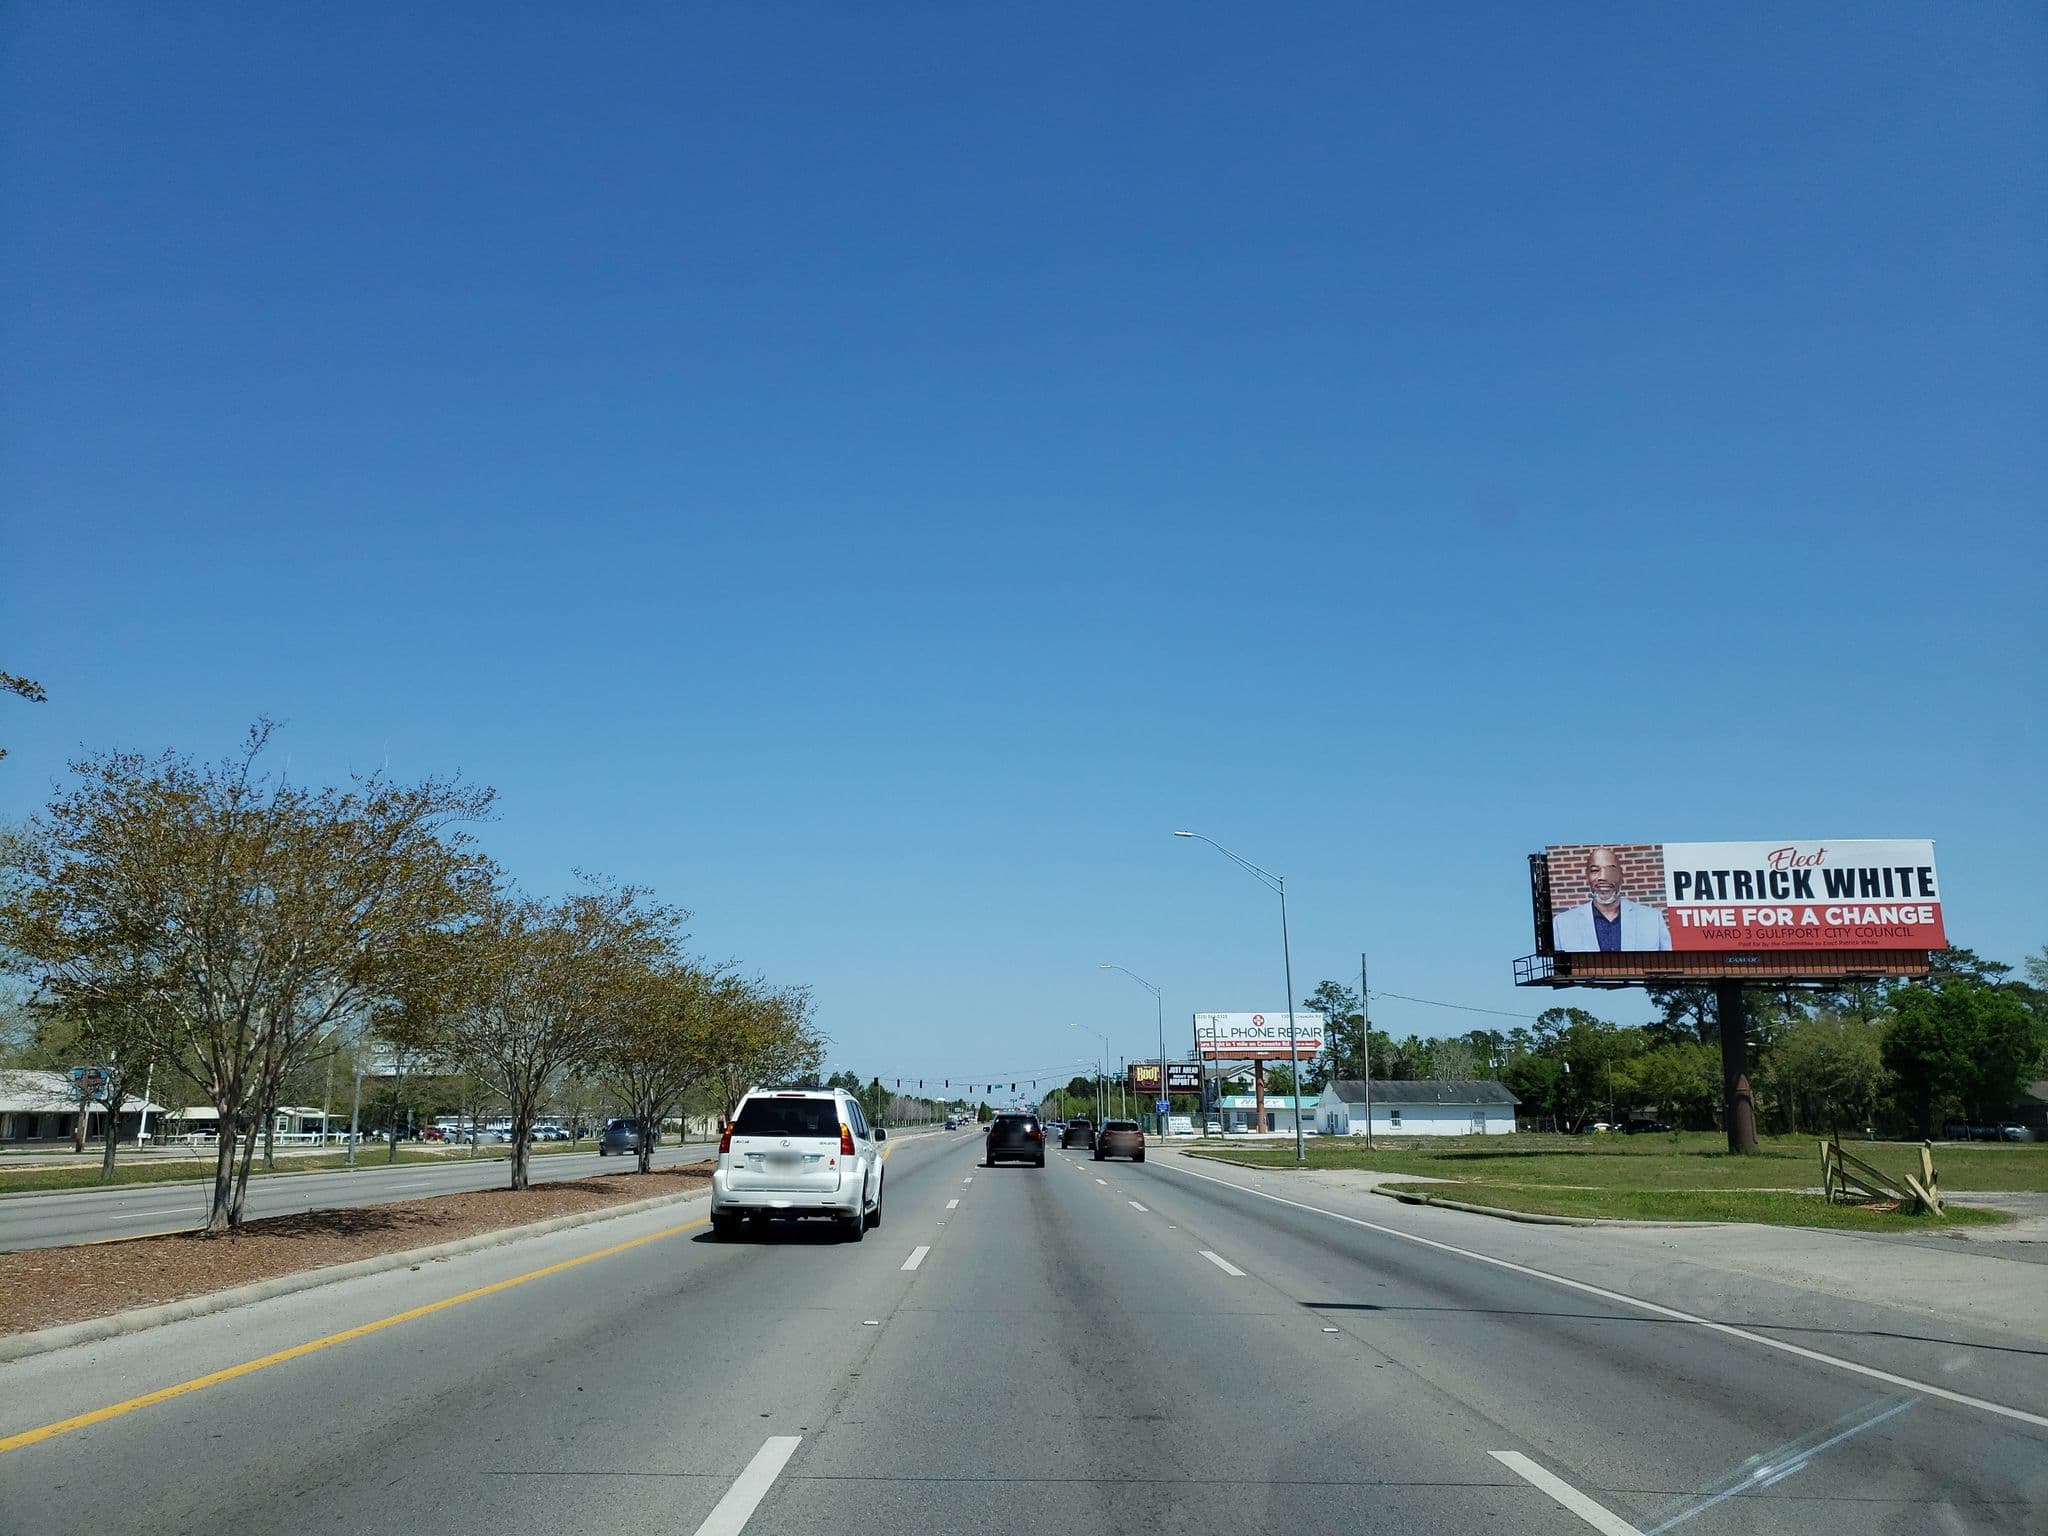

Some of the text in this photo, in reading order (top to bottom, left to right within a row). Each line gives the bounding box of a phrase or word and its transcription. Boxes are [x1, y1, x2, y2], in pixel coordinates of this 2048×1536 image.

[1768, 847, 1827, 871] Elect
[1673, 867, 1936, 901] PATRICK WHITE
[1676, 906, 1935, 927] TIME FOR A CHANGE
[1703, 927, 1914, 939] WARD 3 GULFPORT CITY COUNCIL
[1197, 1027, 1322, 1038] CELL PHONE REPAIR
[1168, 1066, 1198, 1074] JUST AHEAD
